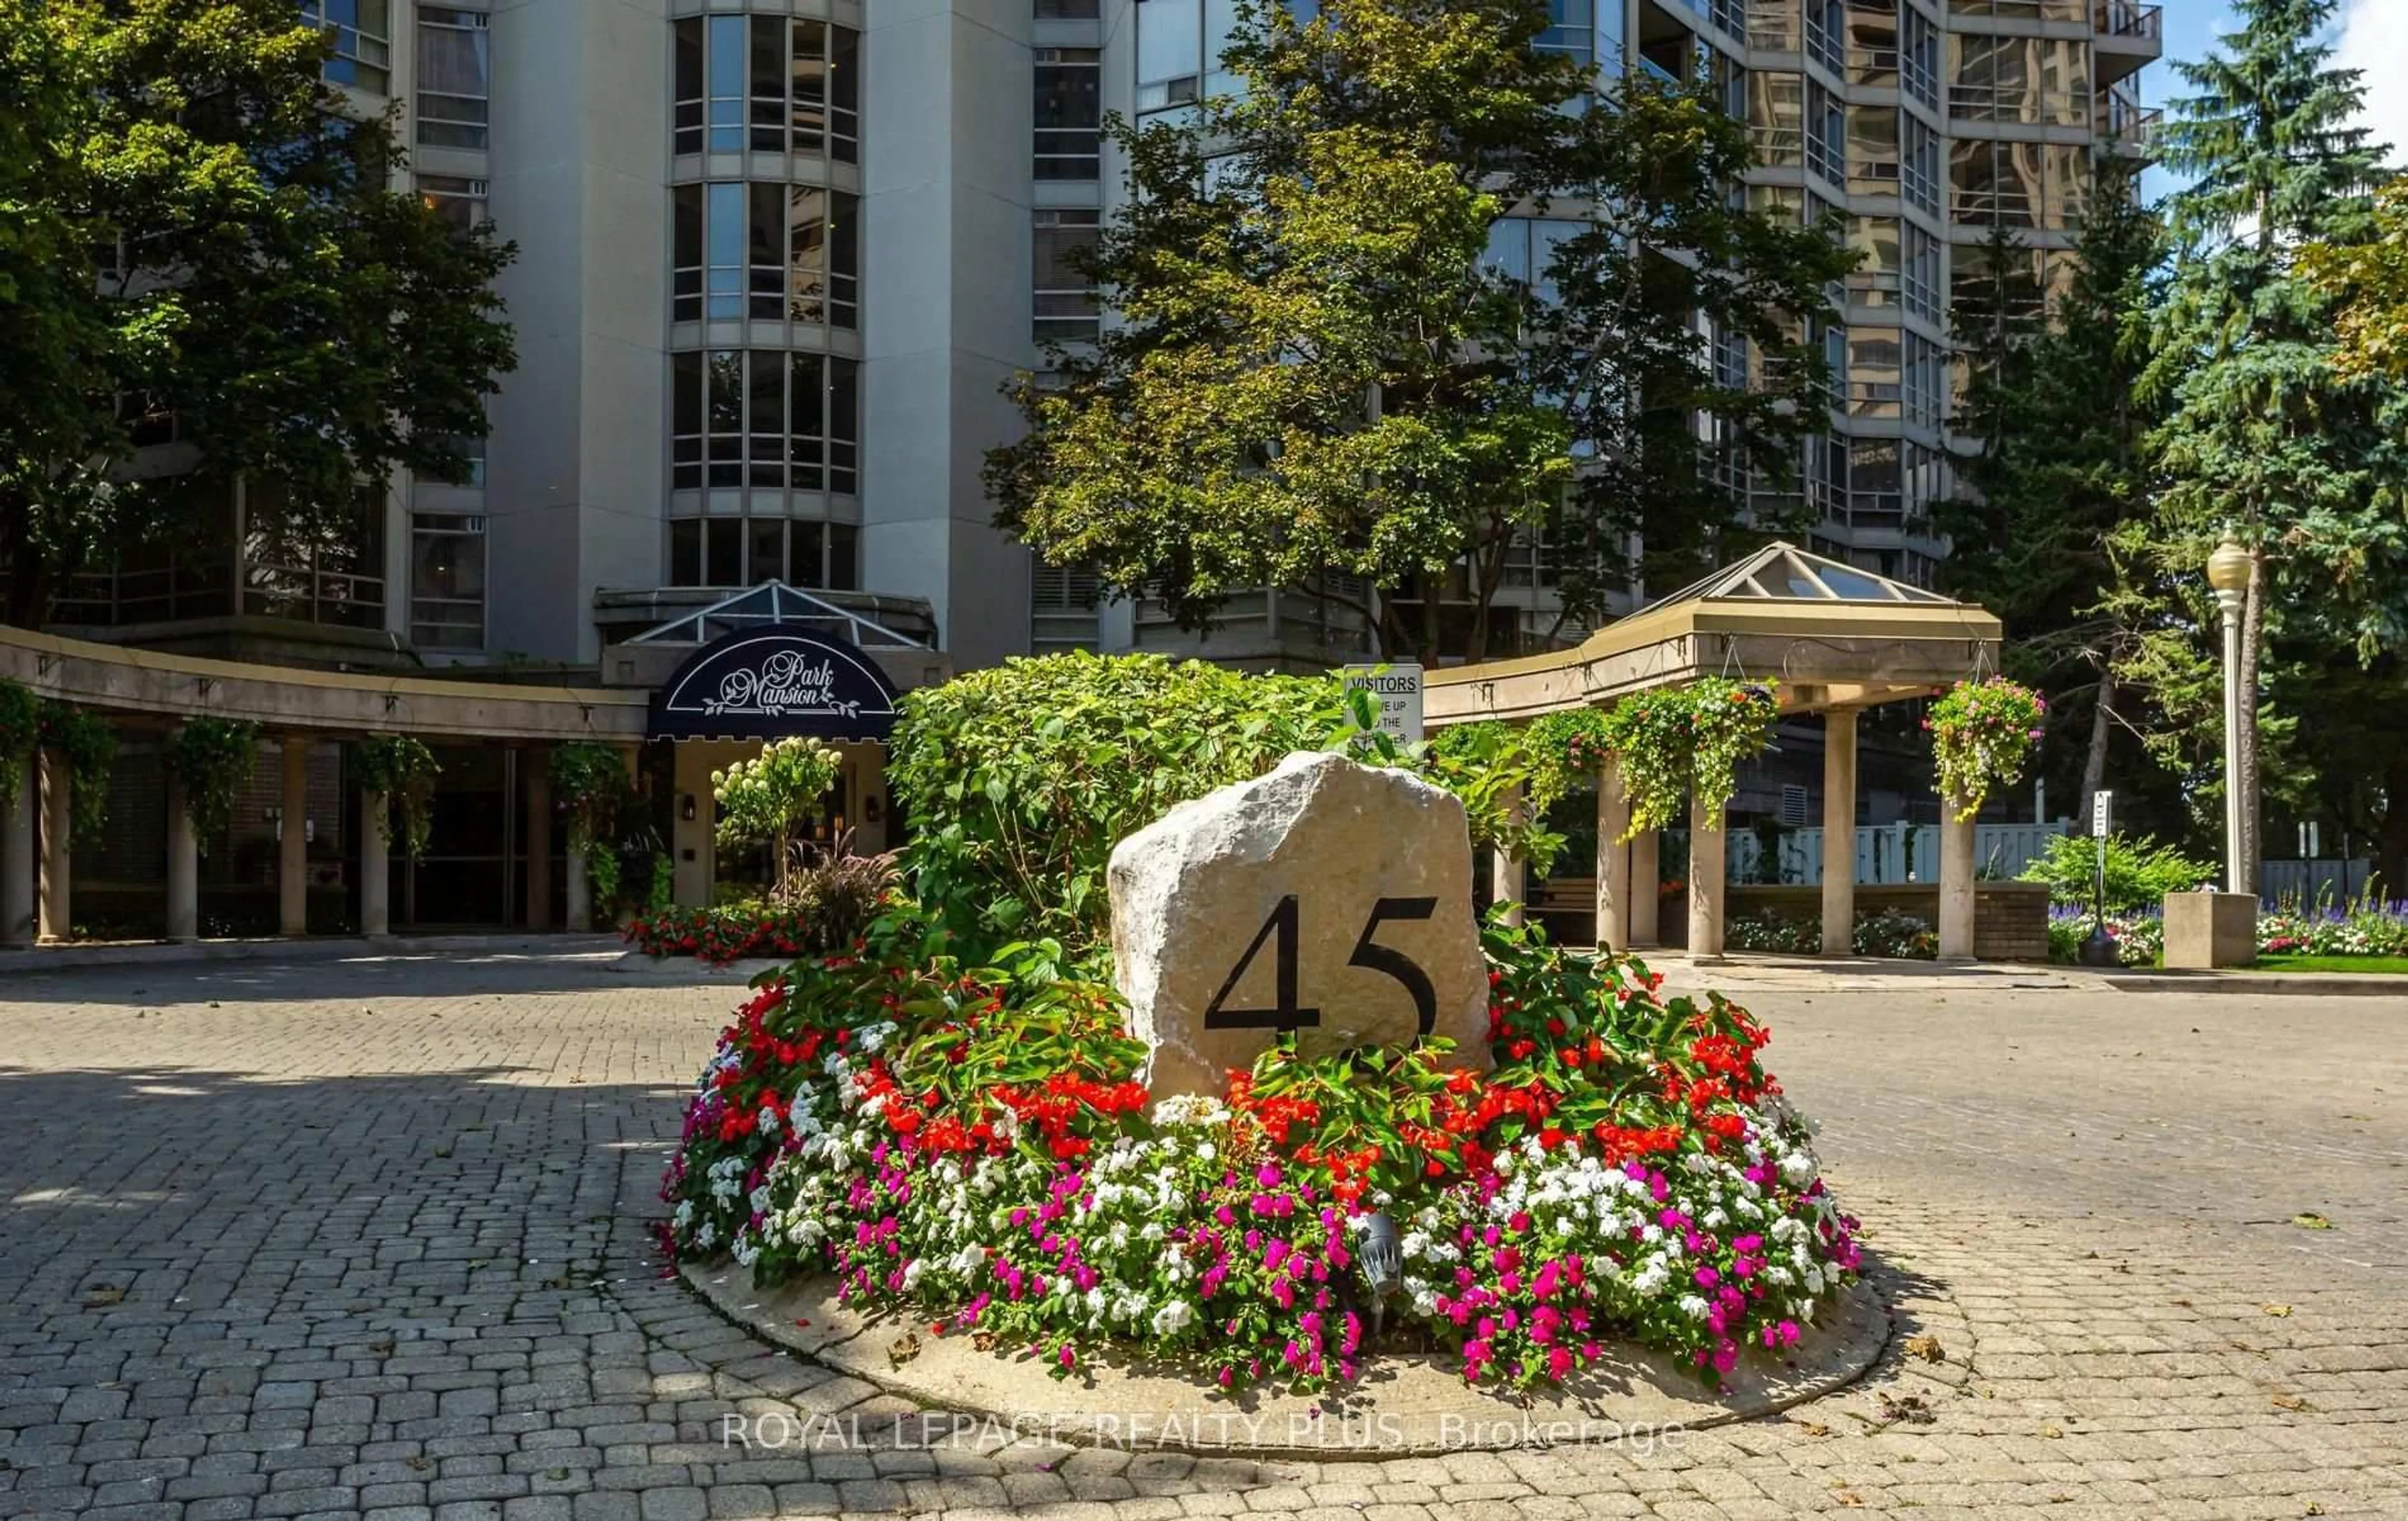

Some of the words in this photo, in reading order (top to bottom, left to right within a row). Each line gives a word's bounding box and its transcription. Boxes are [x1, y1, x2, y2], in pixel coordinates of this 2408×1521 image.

[762, 650, 834, 689] Park
[720, 667, 819, 708] Mansion
[1352, 677, 1416, 691] VISITORS
[1393, 700, 1407, 711] UP
[1383, 717, 1400, 728] THE
[1204, 894, 1439, 1074] 45
